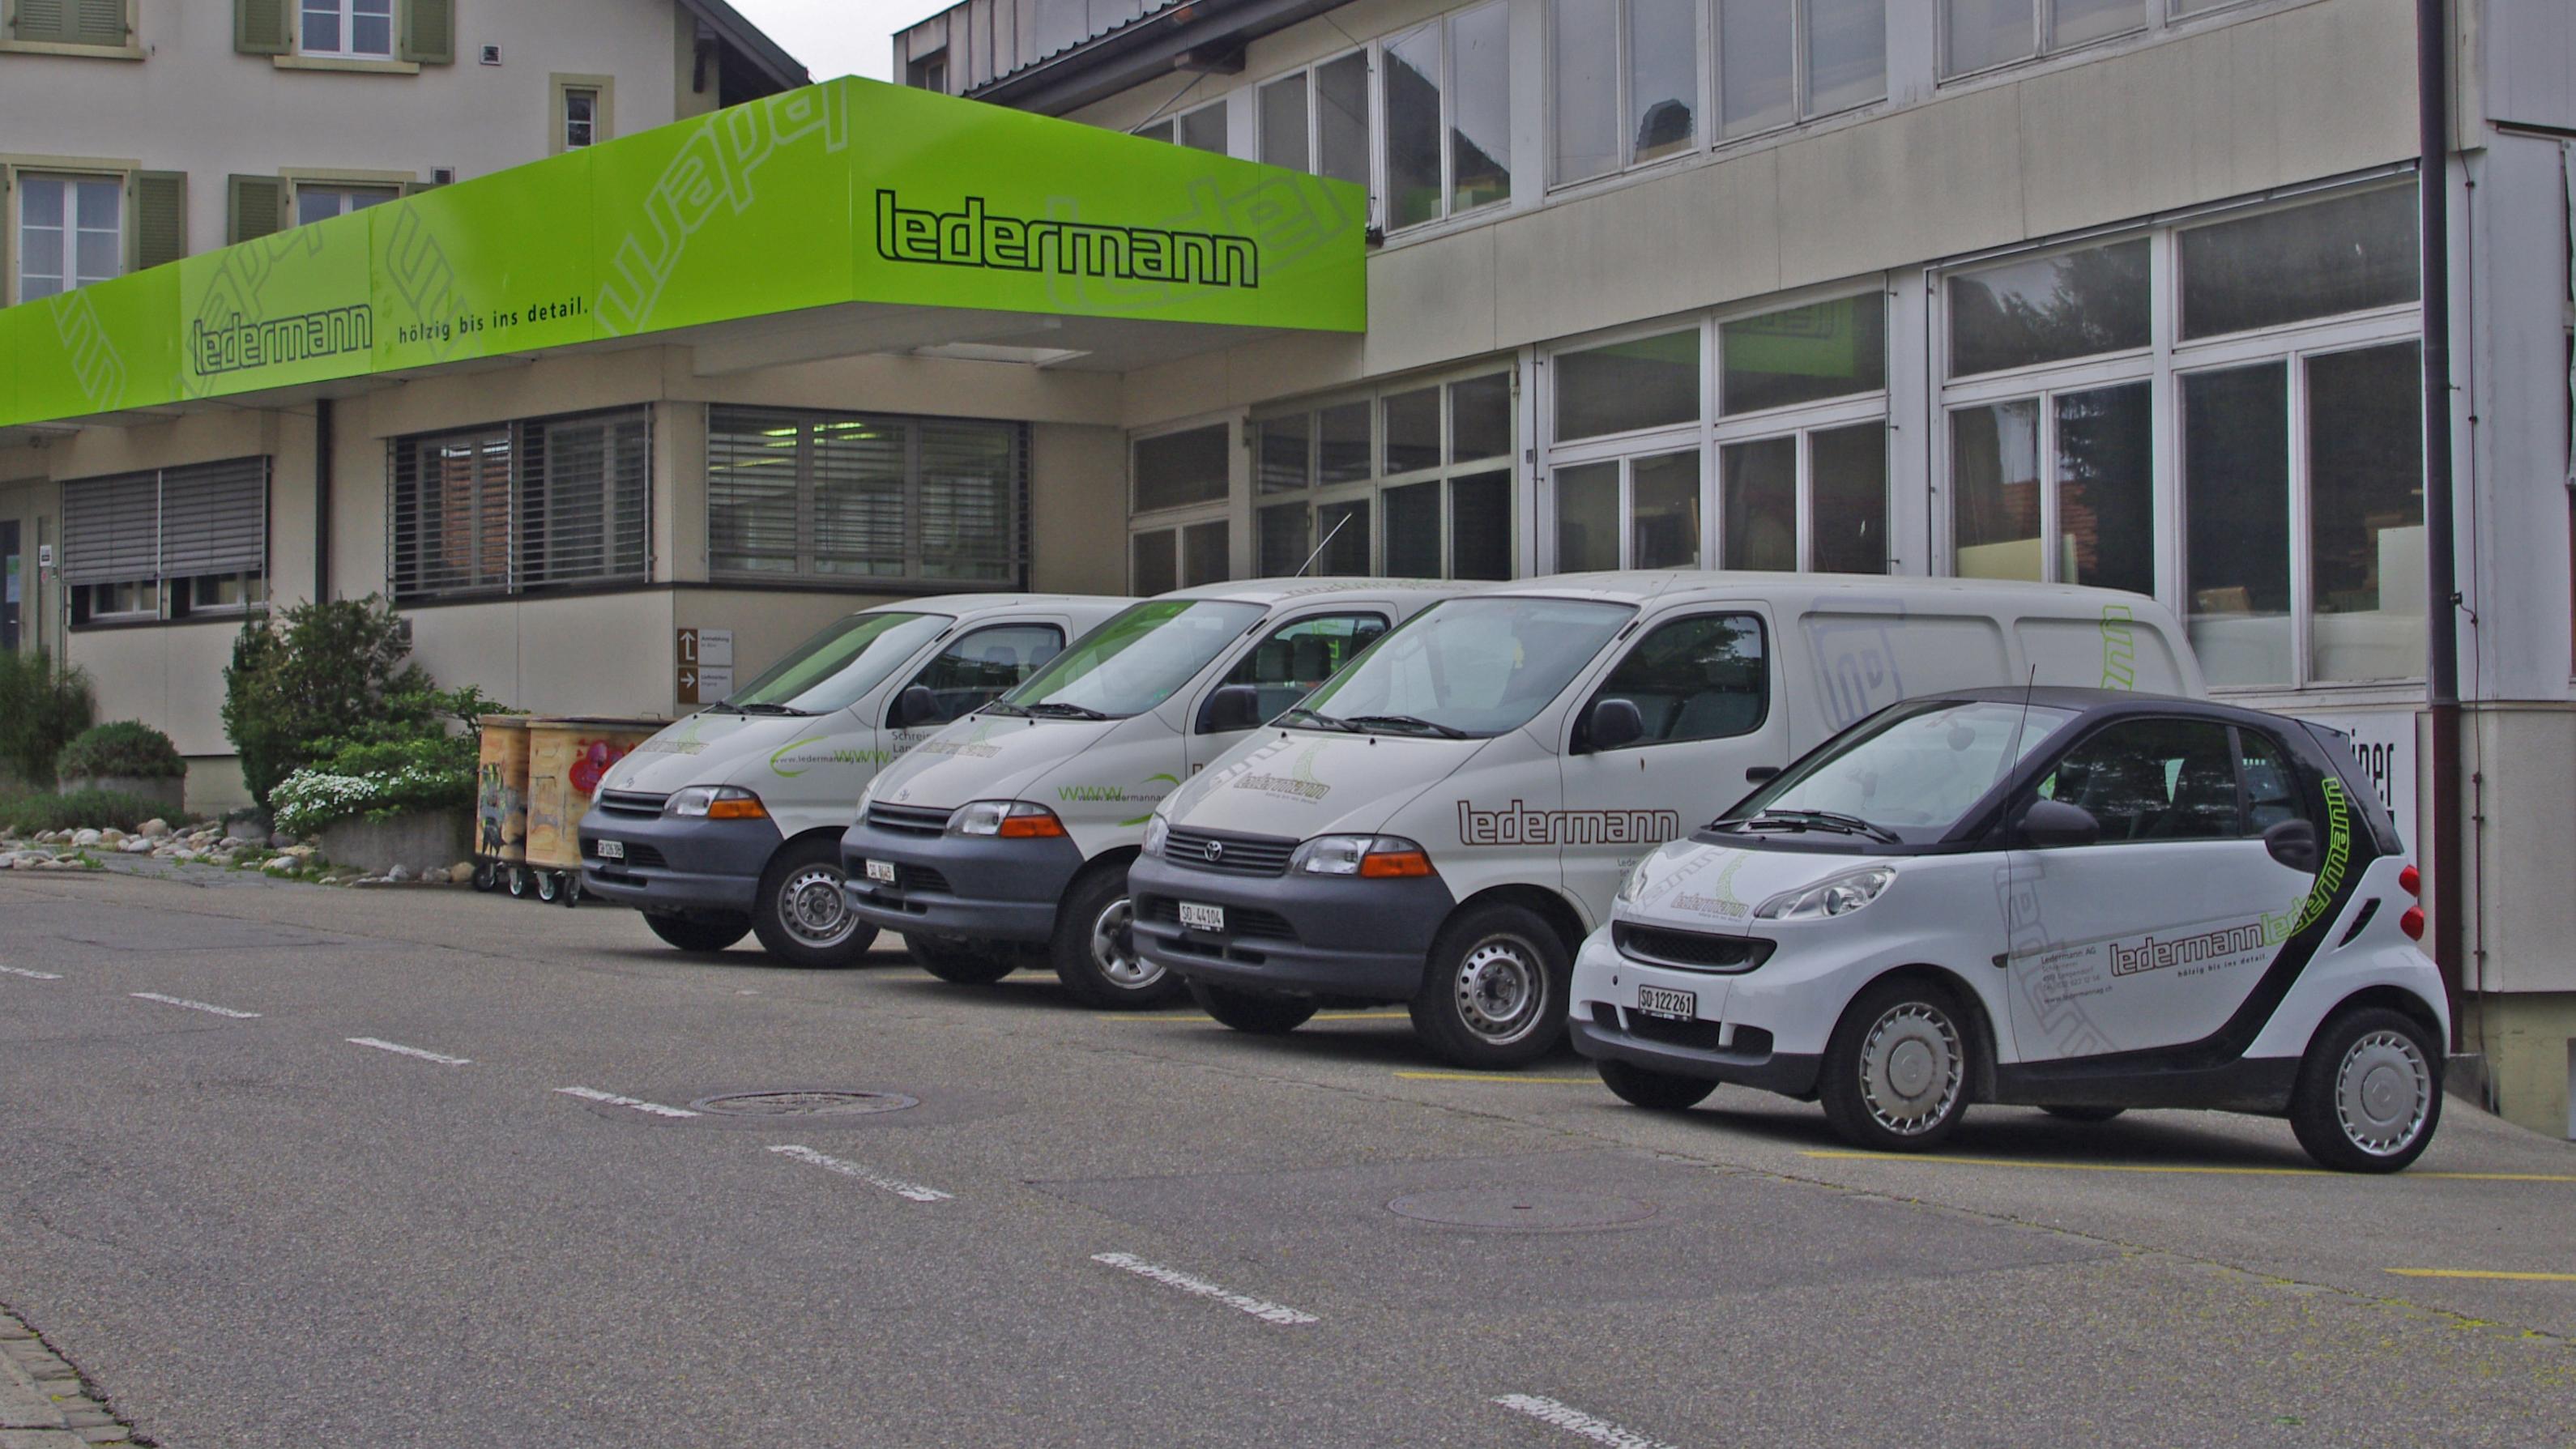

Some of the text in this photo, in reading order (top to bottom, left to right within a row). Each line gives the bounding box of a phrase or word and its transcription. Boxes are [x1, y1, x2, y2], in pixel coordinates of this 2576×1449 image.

[876, 189, 1259, 288] ledermann
[194, 304, 373, 376] ledermann
[399, 296, 589, 344] hölzig bis ins detail.
[1457, 799, 1679, 846] ledermann
[2109, 923, 2264, 977] ledermann
